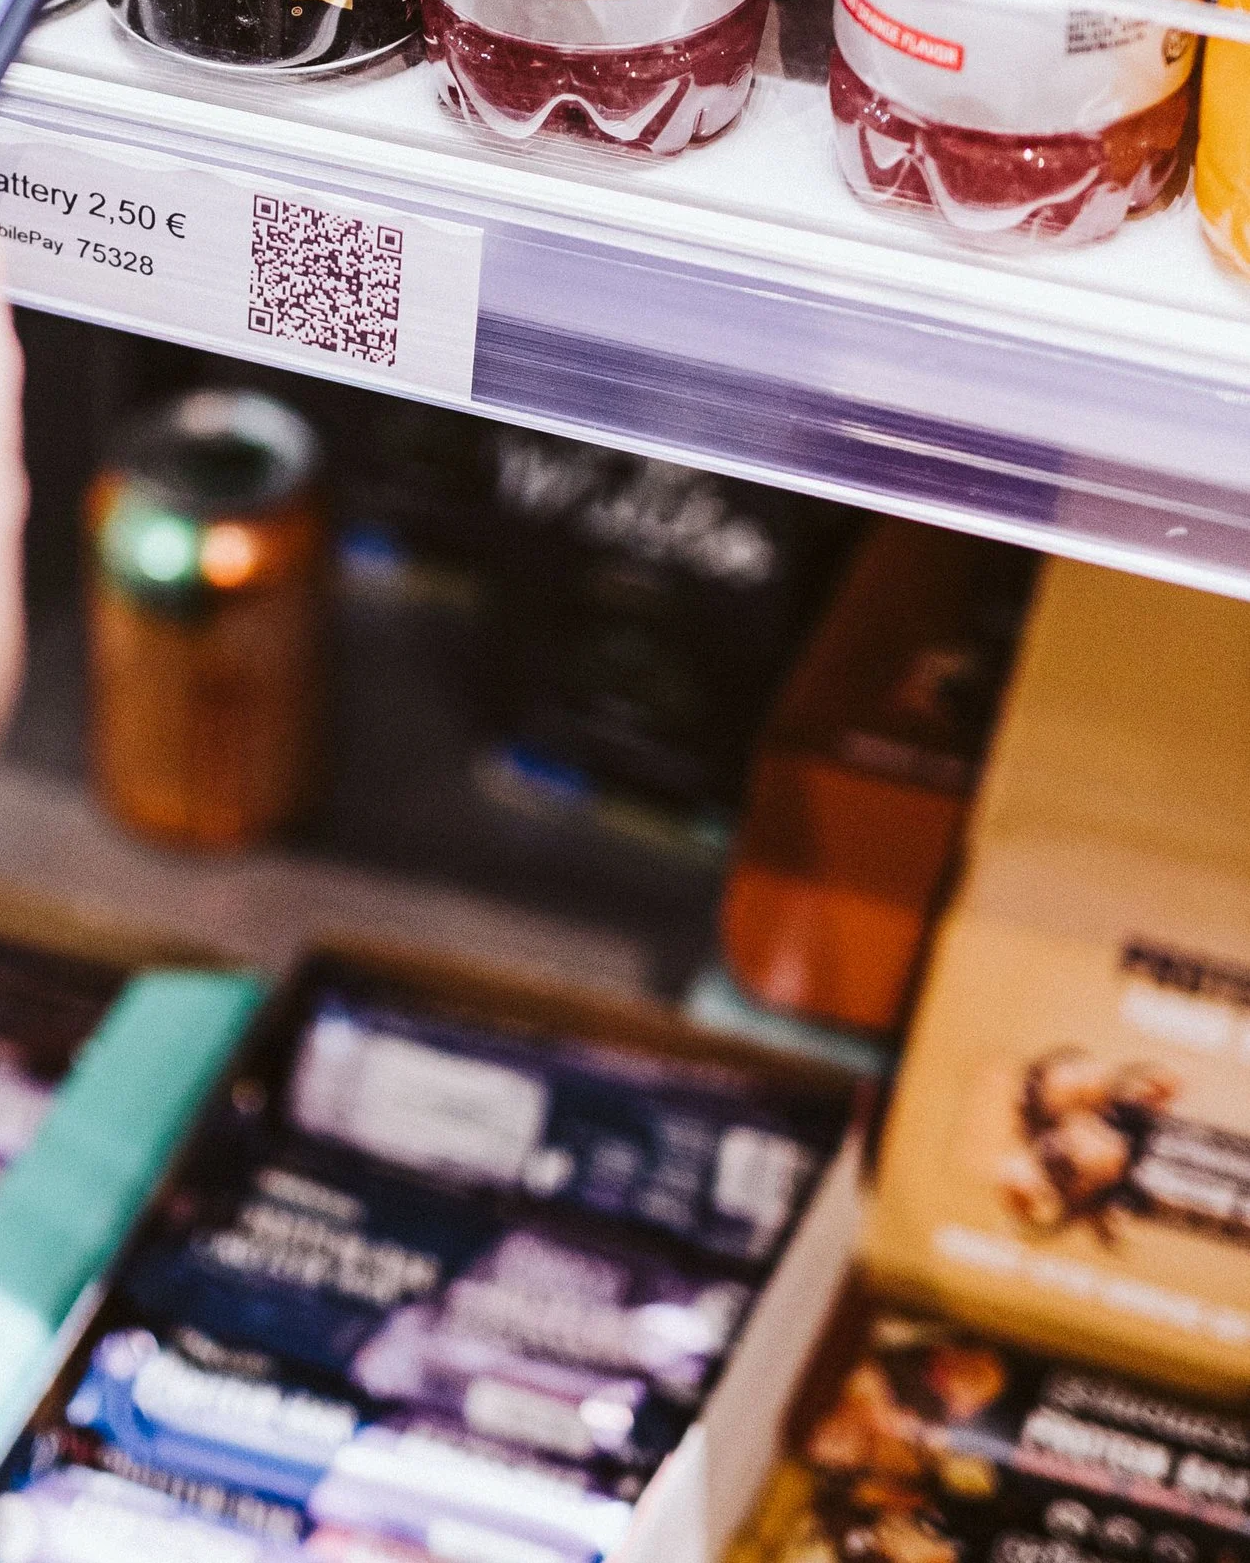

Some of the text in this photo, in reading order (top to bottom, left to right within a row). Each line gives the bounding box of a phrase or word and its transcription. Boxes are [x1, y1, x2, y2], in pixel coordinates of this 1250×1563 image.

[88, 191, 157, 231] 2,50
[165, 212, 188, 239] €
[76, 237, 155, 277] 75328
